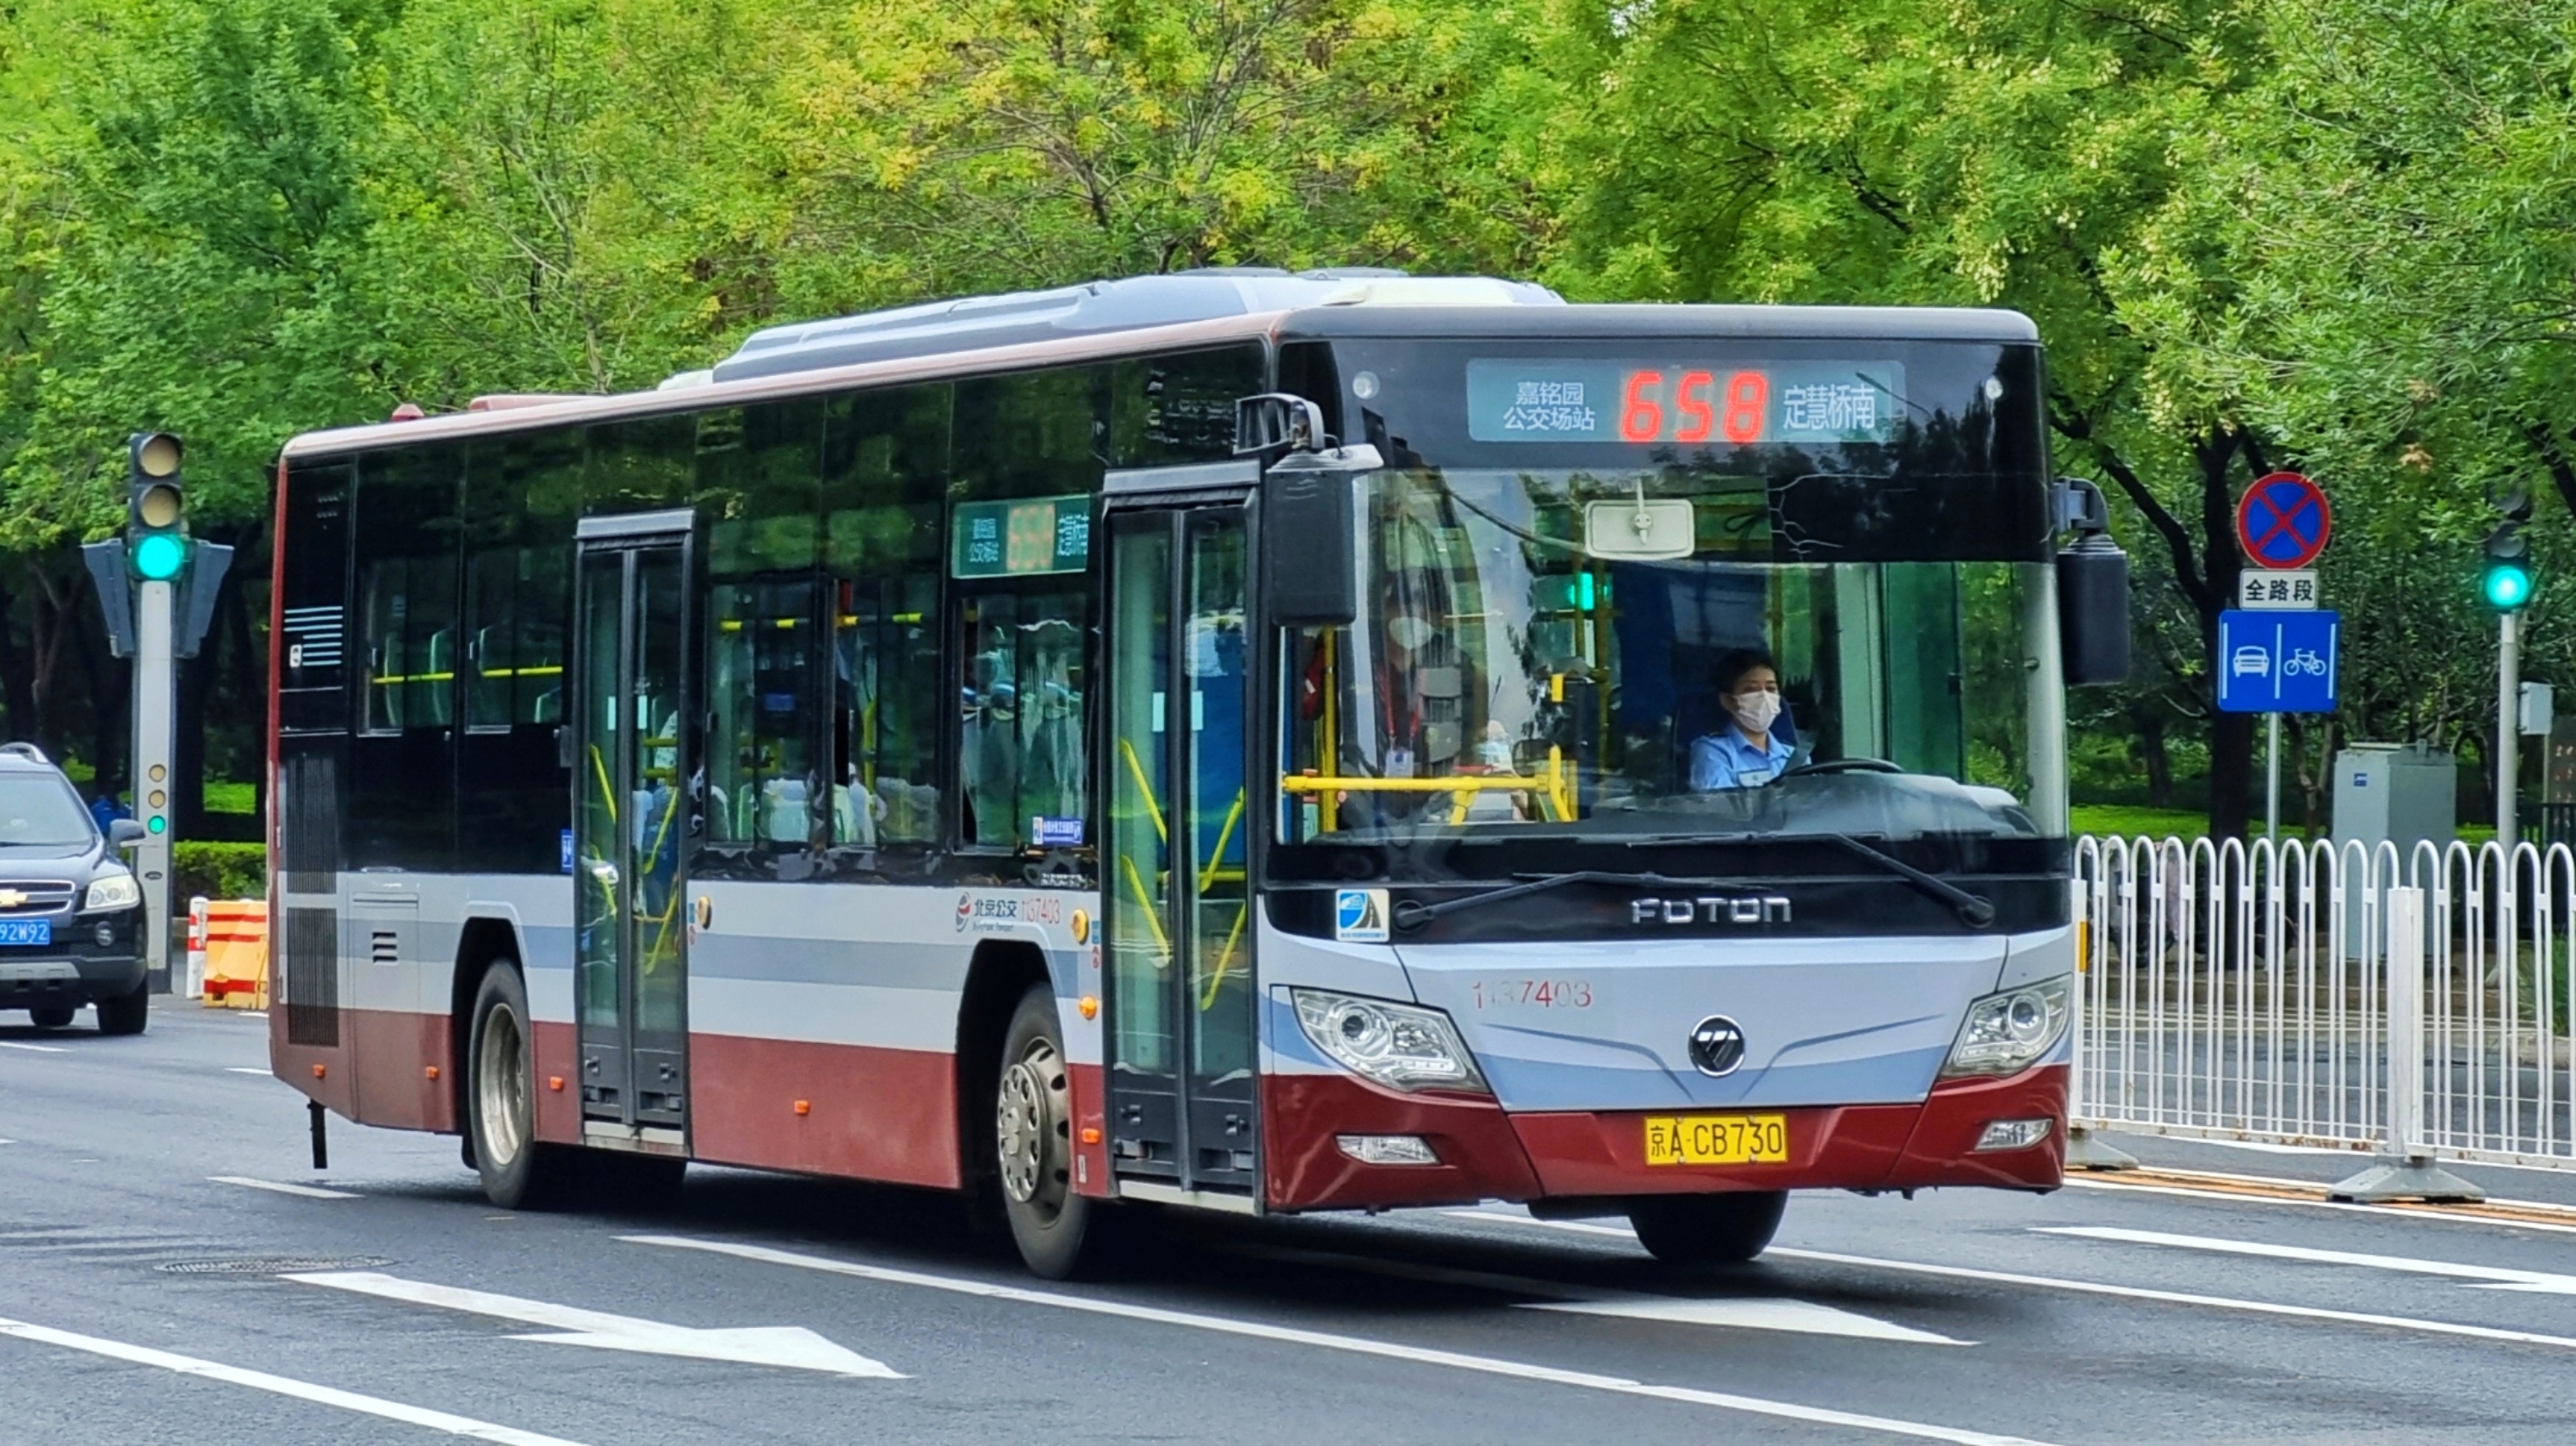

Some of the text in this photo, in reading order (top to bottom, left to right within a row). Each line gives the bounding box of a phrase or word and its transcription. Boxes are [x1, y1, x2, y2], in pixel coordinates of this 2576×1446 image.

[1515, 382, 1583, 406] 嘉铭园
[1783, 384, 1875, 429] 定慧桥南
[1503, 406, 1595, 430] 公交场站
[1621, 371, 1770, 443] 658
[2245, 579, 2313, 602] 全路段
[974, 900, 1017, 917] 北京公交
[1632, 897, 1791, 923] FOTON
[1650, 1122, 1783, 1157] 京A·CB730
